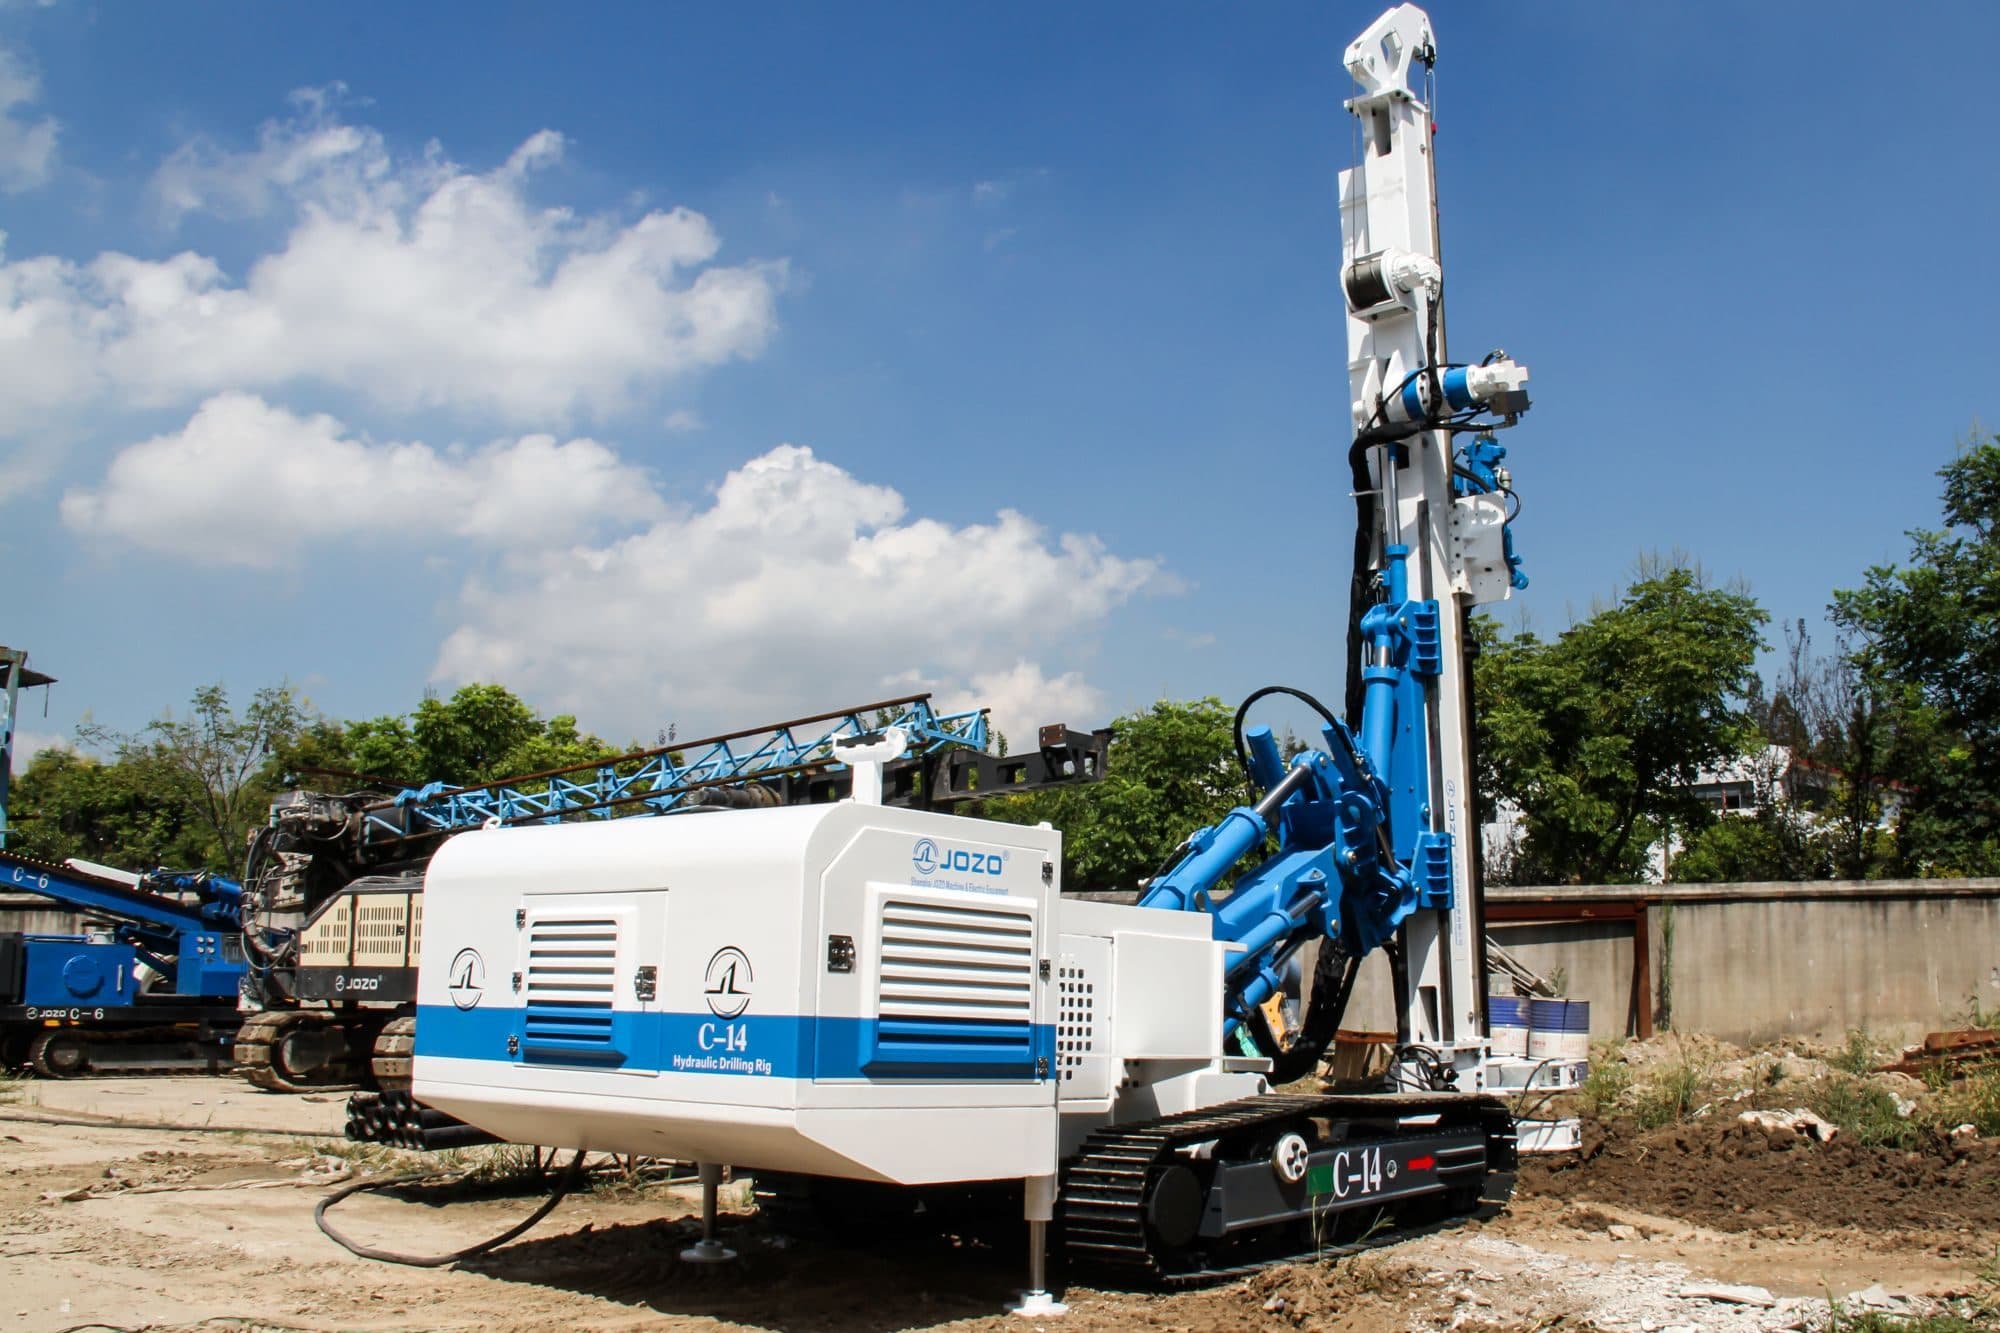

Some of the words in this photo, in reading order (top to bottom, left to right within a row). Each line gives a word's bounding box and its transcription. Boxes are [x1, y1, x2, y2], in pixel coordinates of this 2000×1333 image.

[939, 849, 1002, 876] JOZO
[13, 866, 50, 889] C-6
[345, 977, 378, 990] JOZO
[698, 1022, 747, 1052] C-14
[673, 1054, 718, 1070] Hydraulic
[719, 1056, 753, 1074] Drilling
[755, 1058, 772, 1076] Rig
[1332, 1146, 1382, 1198] C-14
